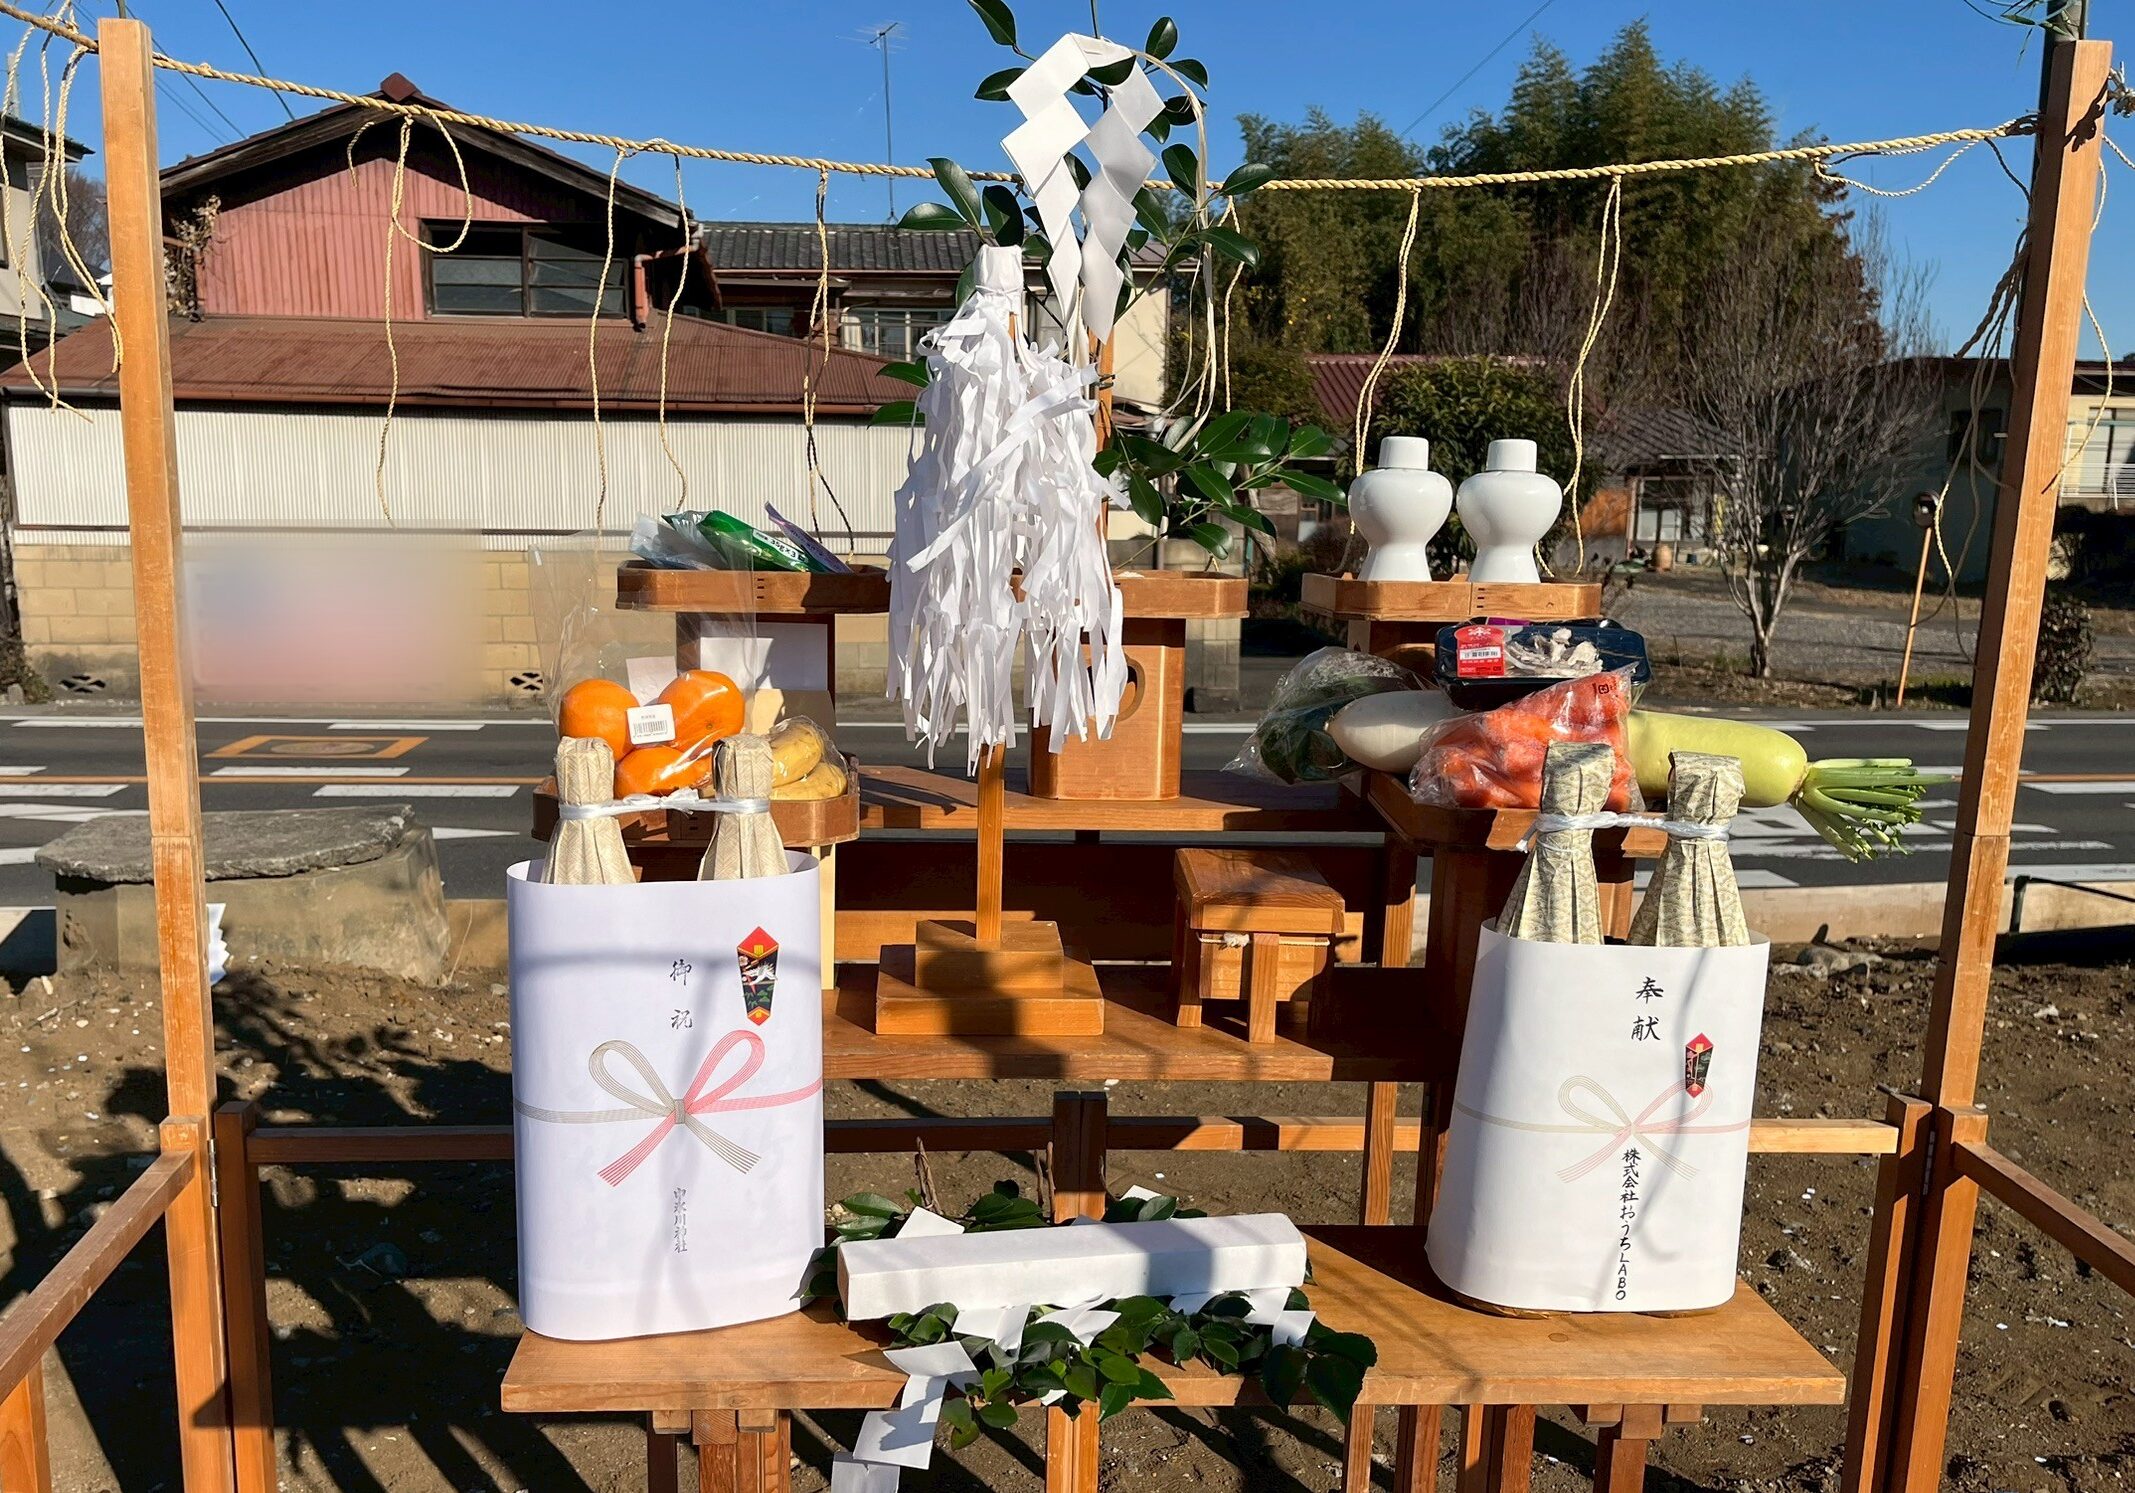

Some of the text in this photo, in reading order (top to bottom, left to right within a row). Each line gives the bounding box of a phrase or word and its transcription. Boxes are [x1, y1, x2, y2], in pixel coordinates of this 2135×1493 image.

[669, 958, 693, 1030] 御祝
[1630, 976, 1665, 1042] 奉献
[1615, 1147, 1642, 1301] 株式会社おうちLABO
